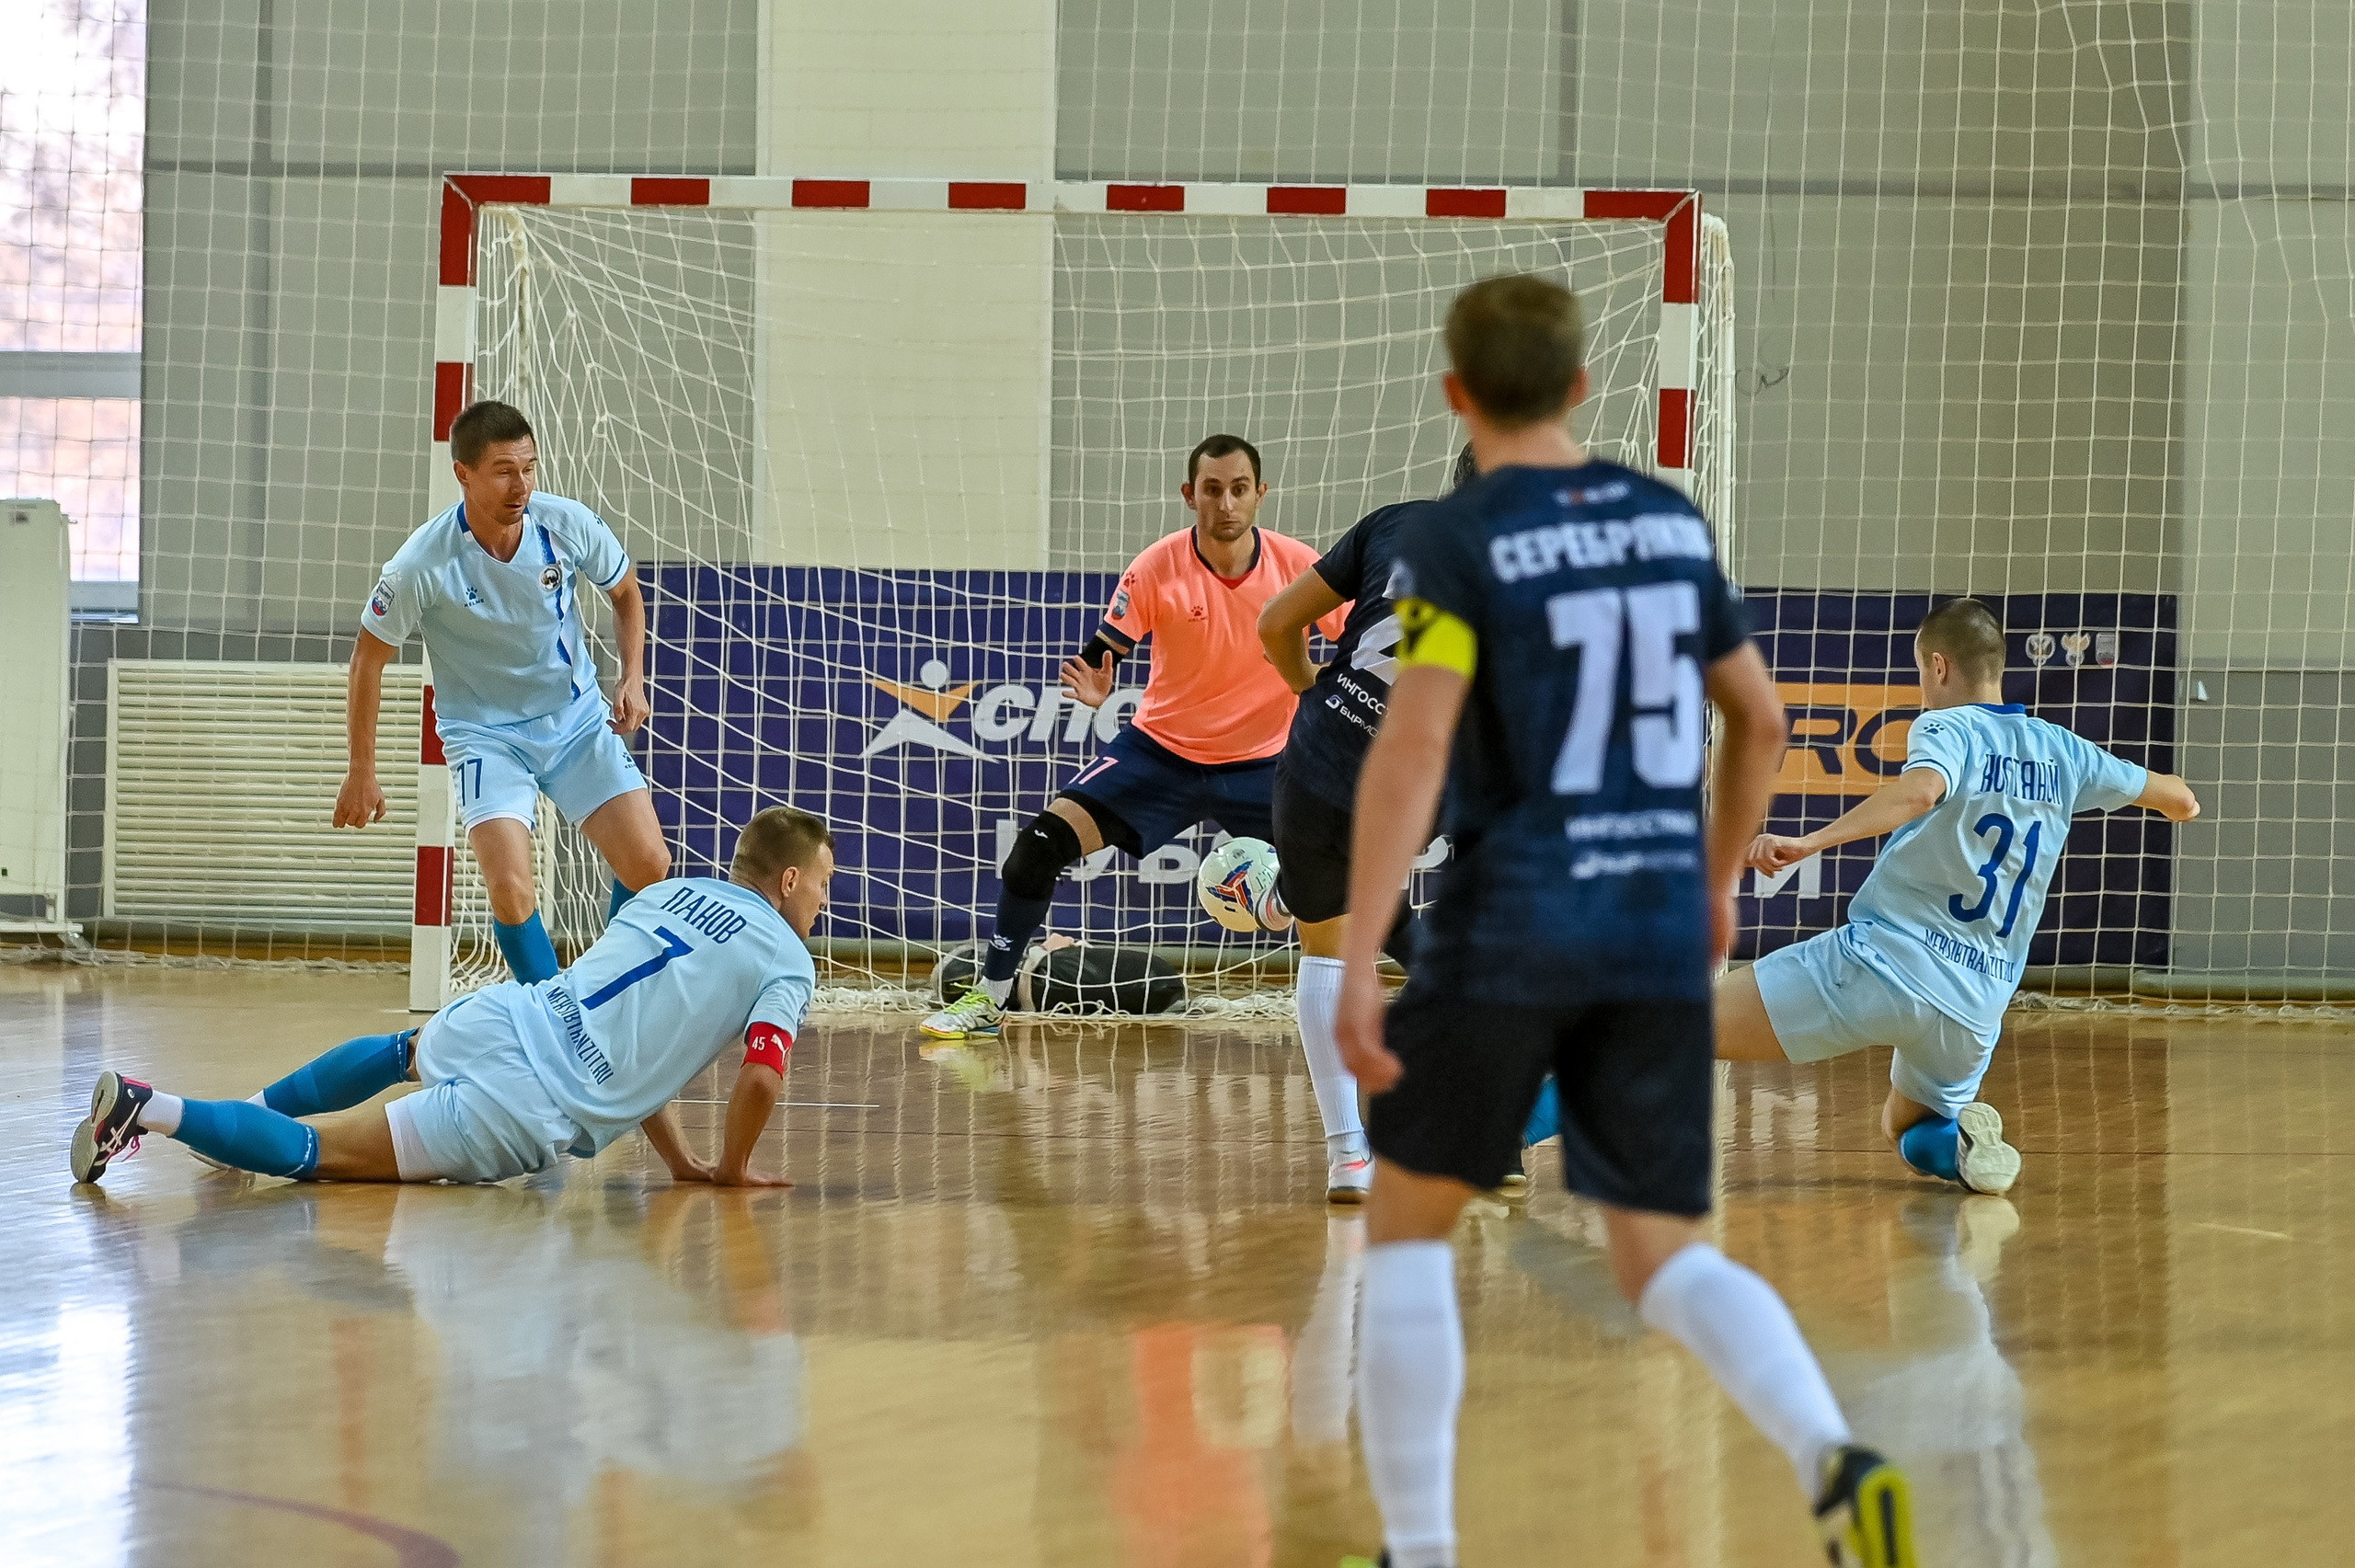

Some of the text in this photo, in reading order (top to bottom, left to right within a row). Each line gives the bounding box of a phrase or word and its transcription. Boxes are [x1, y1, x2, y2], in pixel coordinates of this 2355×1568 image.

[1337, 673, 1387, 715] ИНГОСС
[1546, 580, 1702, 795] 75
[455, 758, 483, 807] 17
[1948, 813, 2042, 938] 31
[660, 887, 747, 944] ПАНОВ
[579, 925, 695, 1011] 7
[752, 1036, 766, 1051] 45
